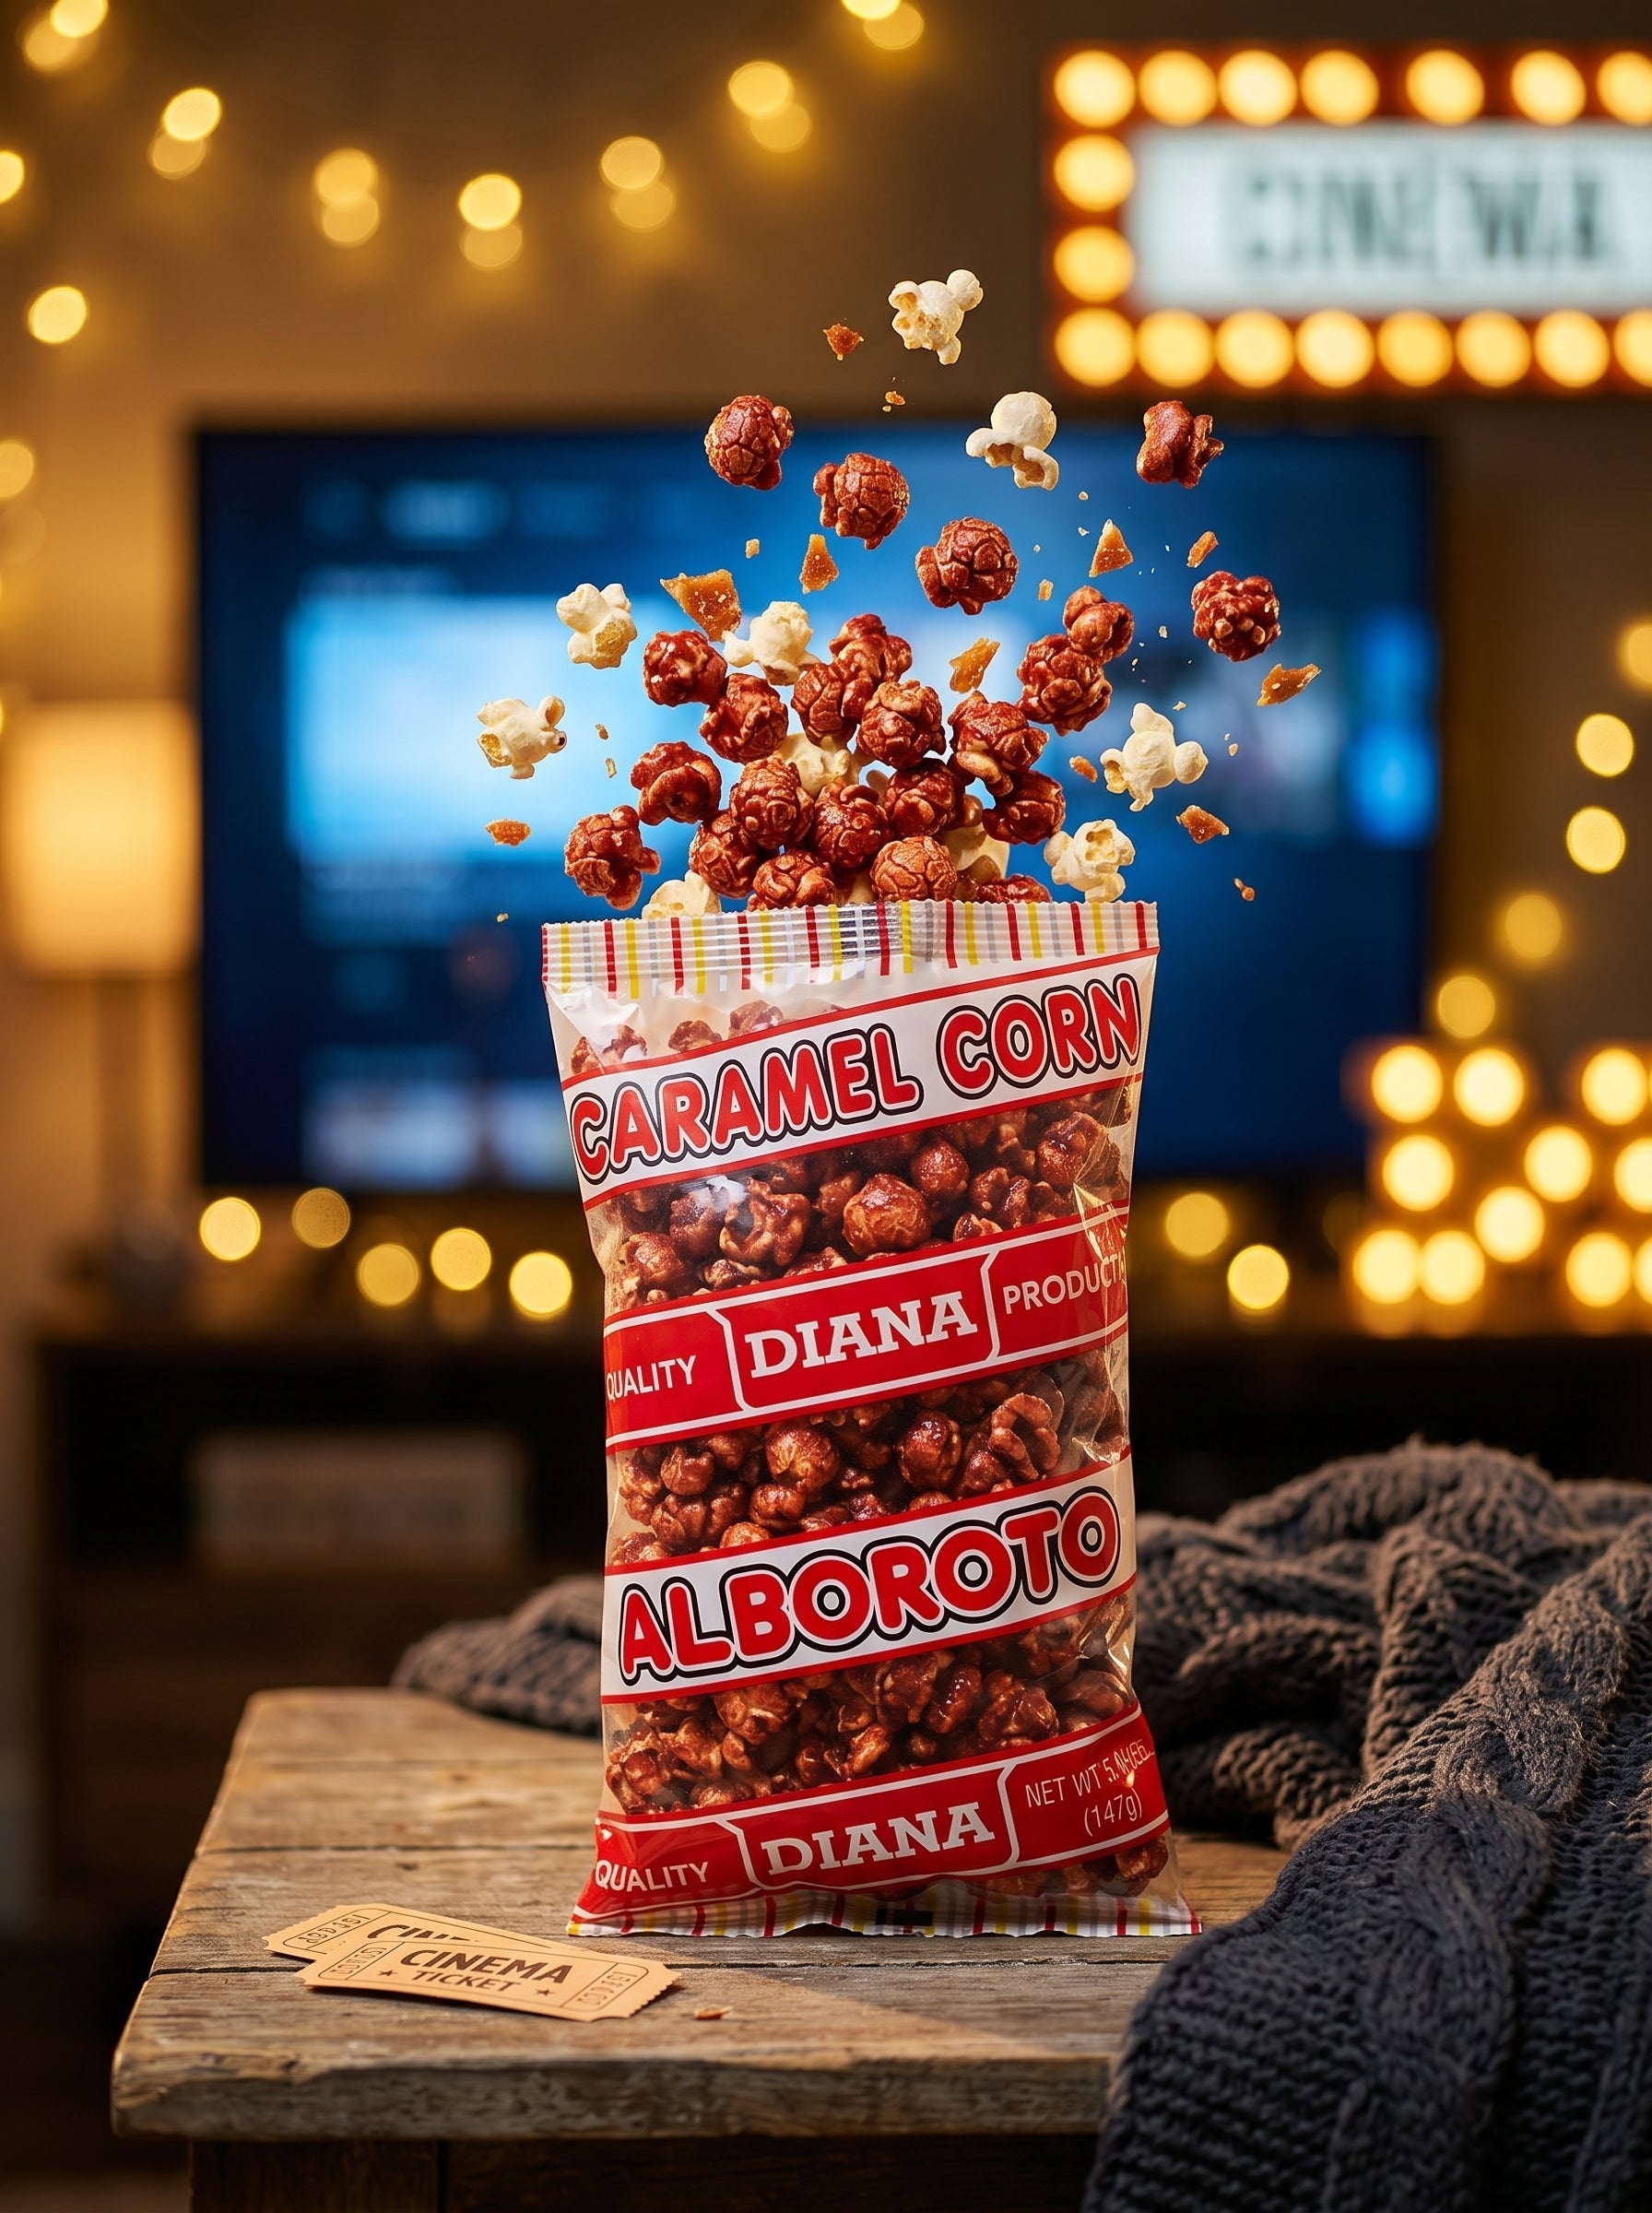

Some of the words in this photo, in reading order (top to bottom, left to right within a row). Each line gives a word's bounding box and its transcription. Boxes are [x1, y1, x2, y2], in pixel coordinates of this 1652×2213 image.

[567, 1023, 923, 1186] CARAMEL
[937, 973, 1141, 1099] CORN
[606, 1355, 697, 1403] QUALITY
[744, 1291, 978, 1379] DIANA
[618, 1485, 1121, 1686] ALBOROTO
[595, 1859, 709, 1892] QUALITY
[761, 1802, 995, 1876] DIANA
[1025, 1776, 1066, 1807] NET
[1084, 1787, 1142, 1837] (147g)
[400, 1949, 573, 1983] CINEMA
[411, 1970, 522, 1992] TICKET
